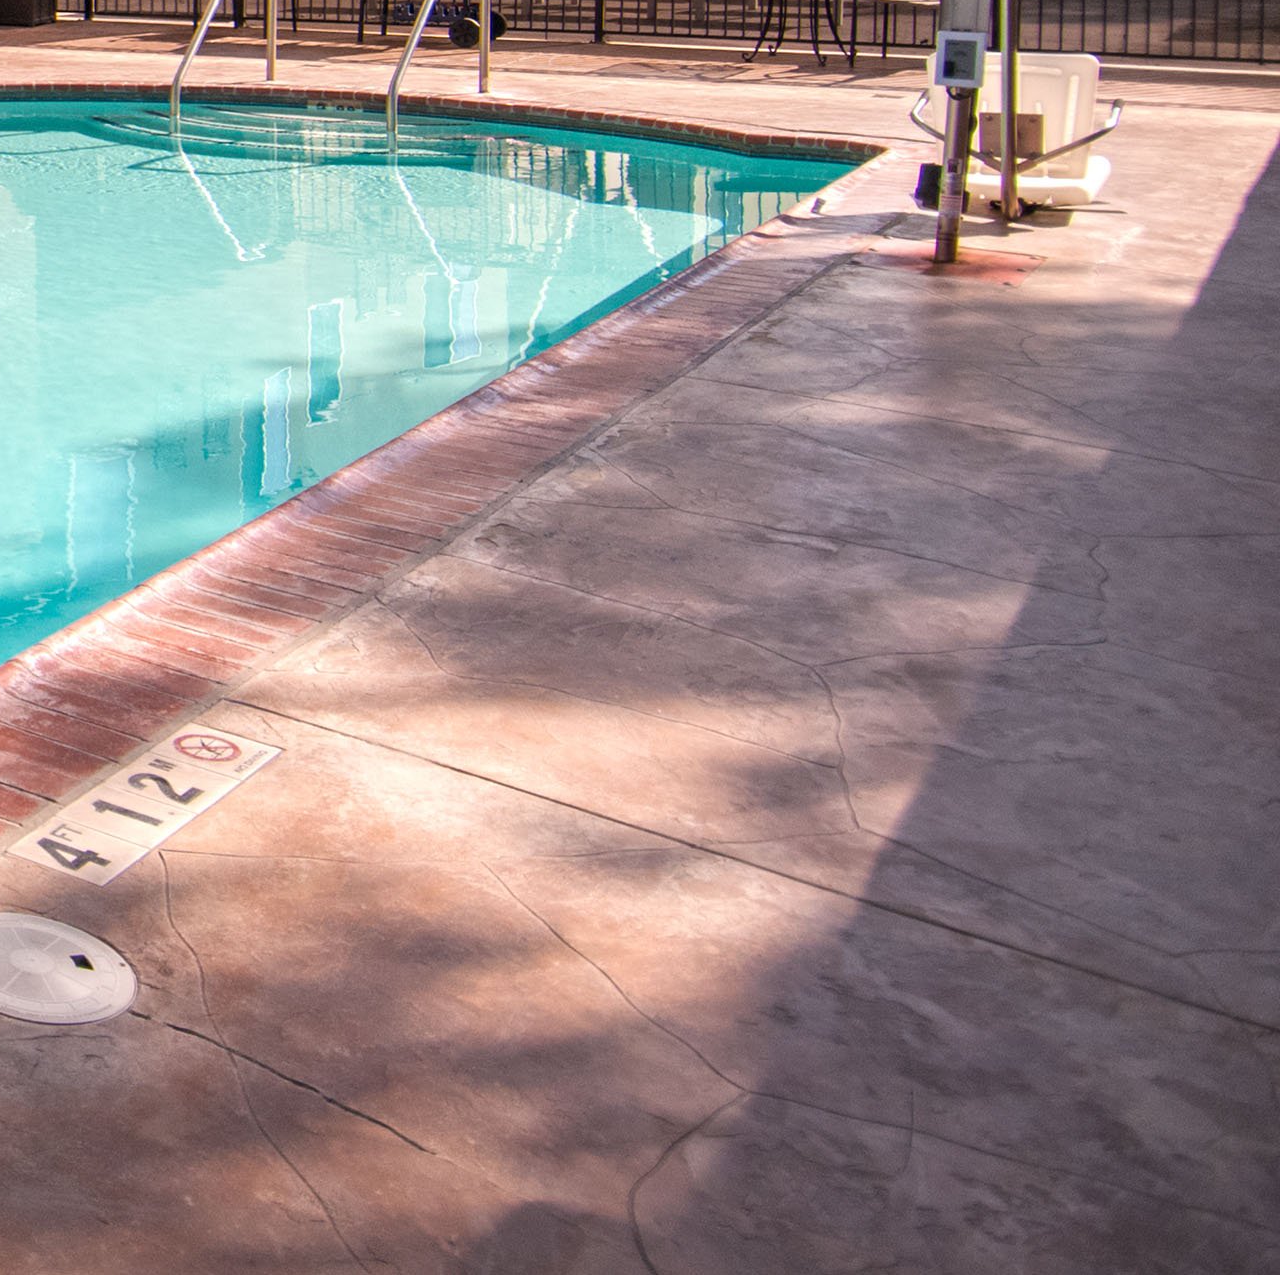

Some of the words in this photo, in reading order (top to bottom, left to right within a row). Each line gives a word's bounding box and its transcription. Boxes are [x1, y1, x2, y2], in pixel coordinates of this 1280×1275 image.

[148, 758, 177, 772] M
[247, 749, 269, 767] DIVING
[50, 824, 83, 842] FT
[37, 837, 111, 870] 4
